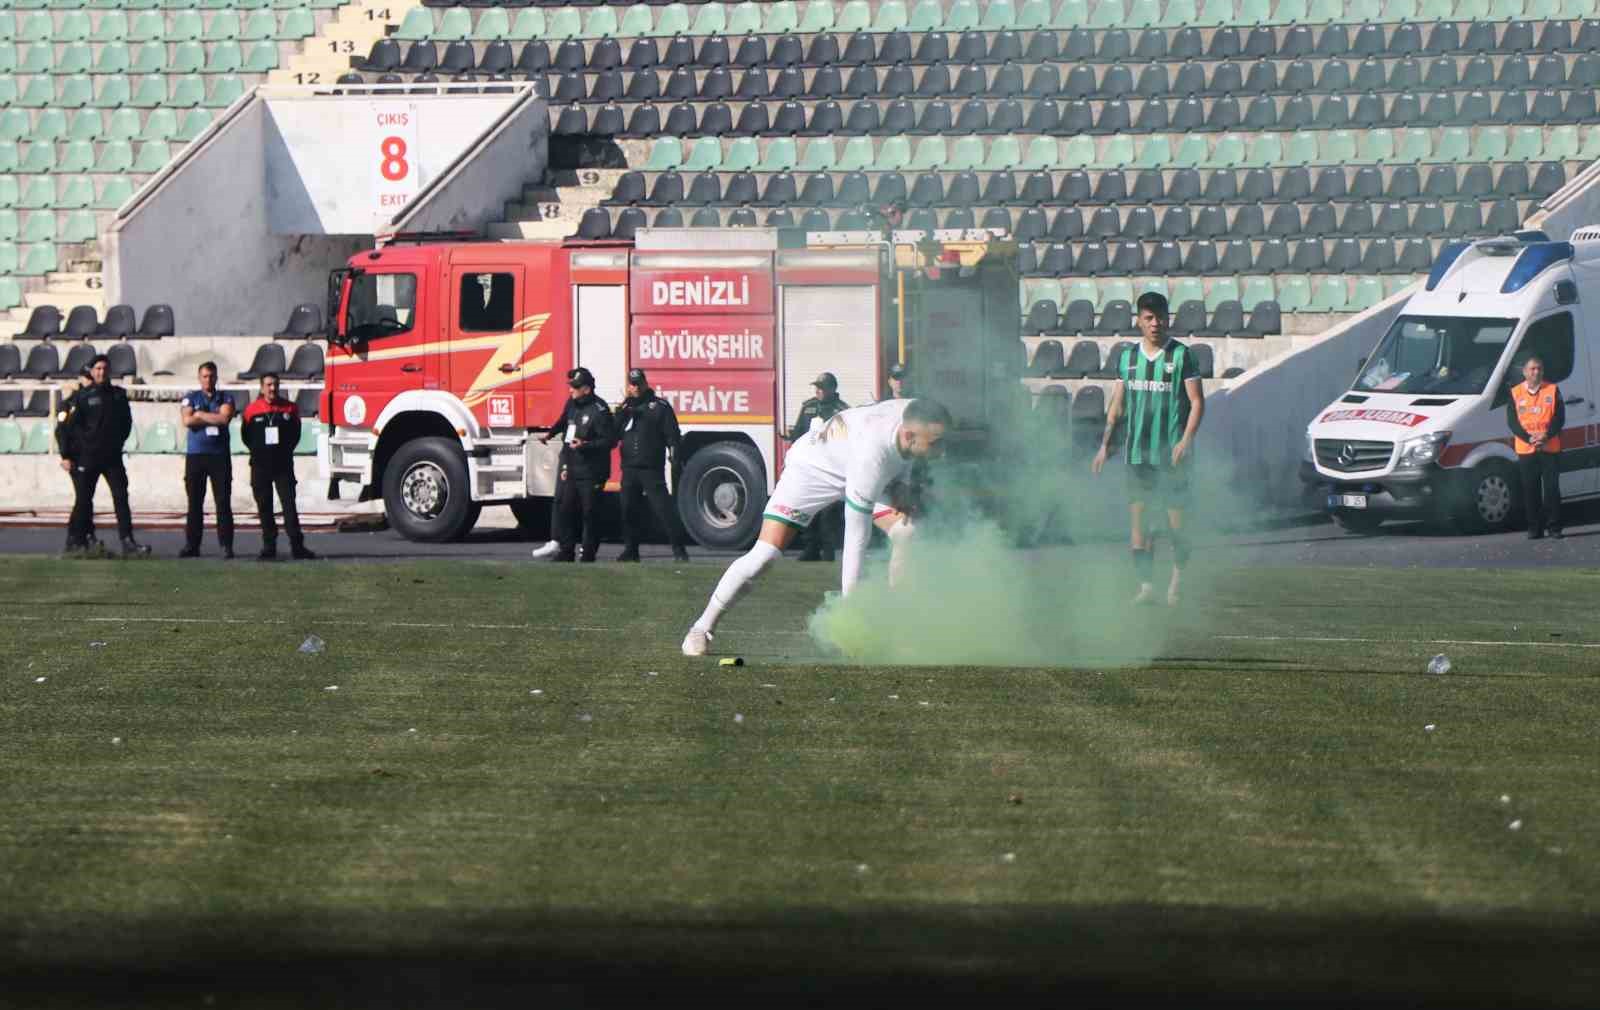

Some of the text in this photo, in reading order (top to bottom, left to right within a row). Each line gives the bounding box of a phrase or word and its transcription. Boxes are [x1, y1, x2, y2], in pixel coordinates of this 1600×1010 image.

[364, 8, 392, 21] 14
[328, 40, 355, 53] 13
[293, 72, 321, 85] 12
[381, 136, 409, 181] 8
[583, 171, 600, 185] 9
[380, 194, 408, 206] EXIT
[544, 204, 560, 219] 8
[86, 277, 103, 289] 6
[652, 275, 750, 306] DENİZLİ
[639, 328, 764, 365] BÜYÜKŞEHİR
[492, 399, 510, 414] 112
